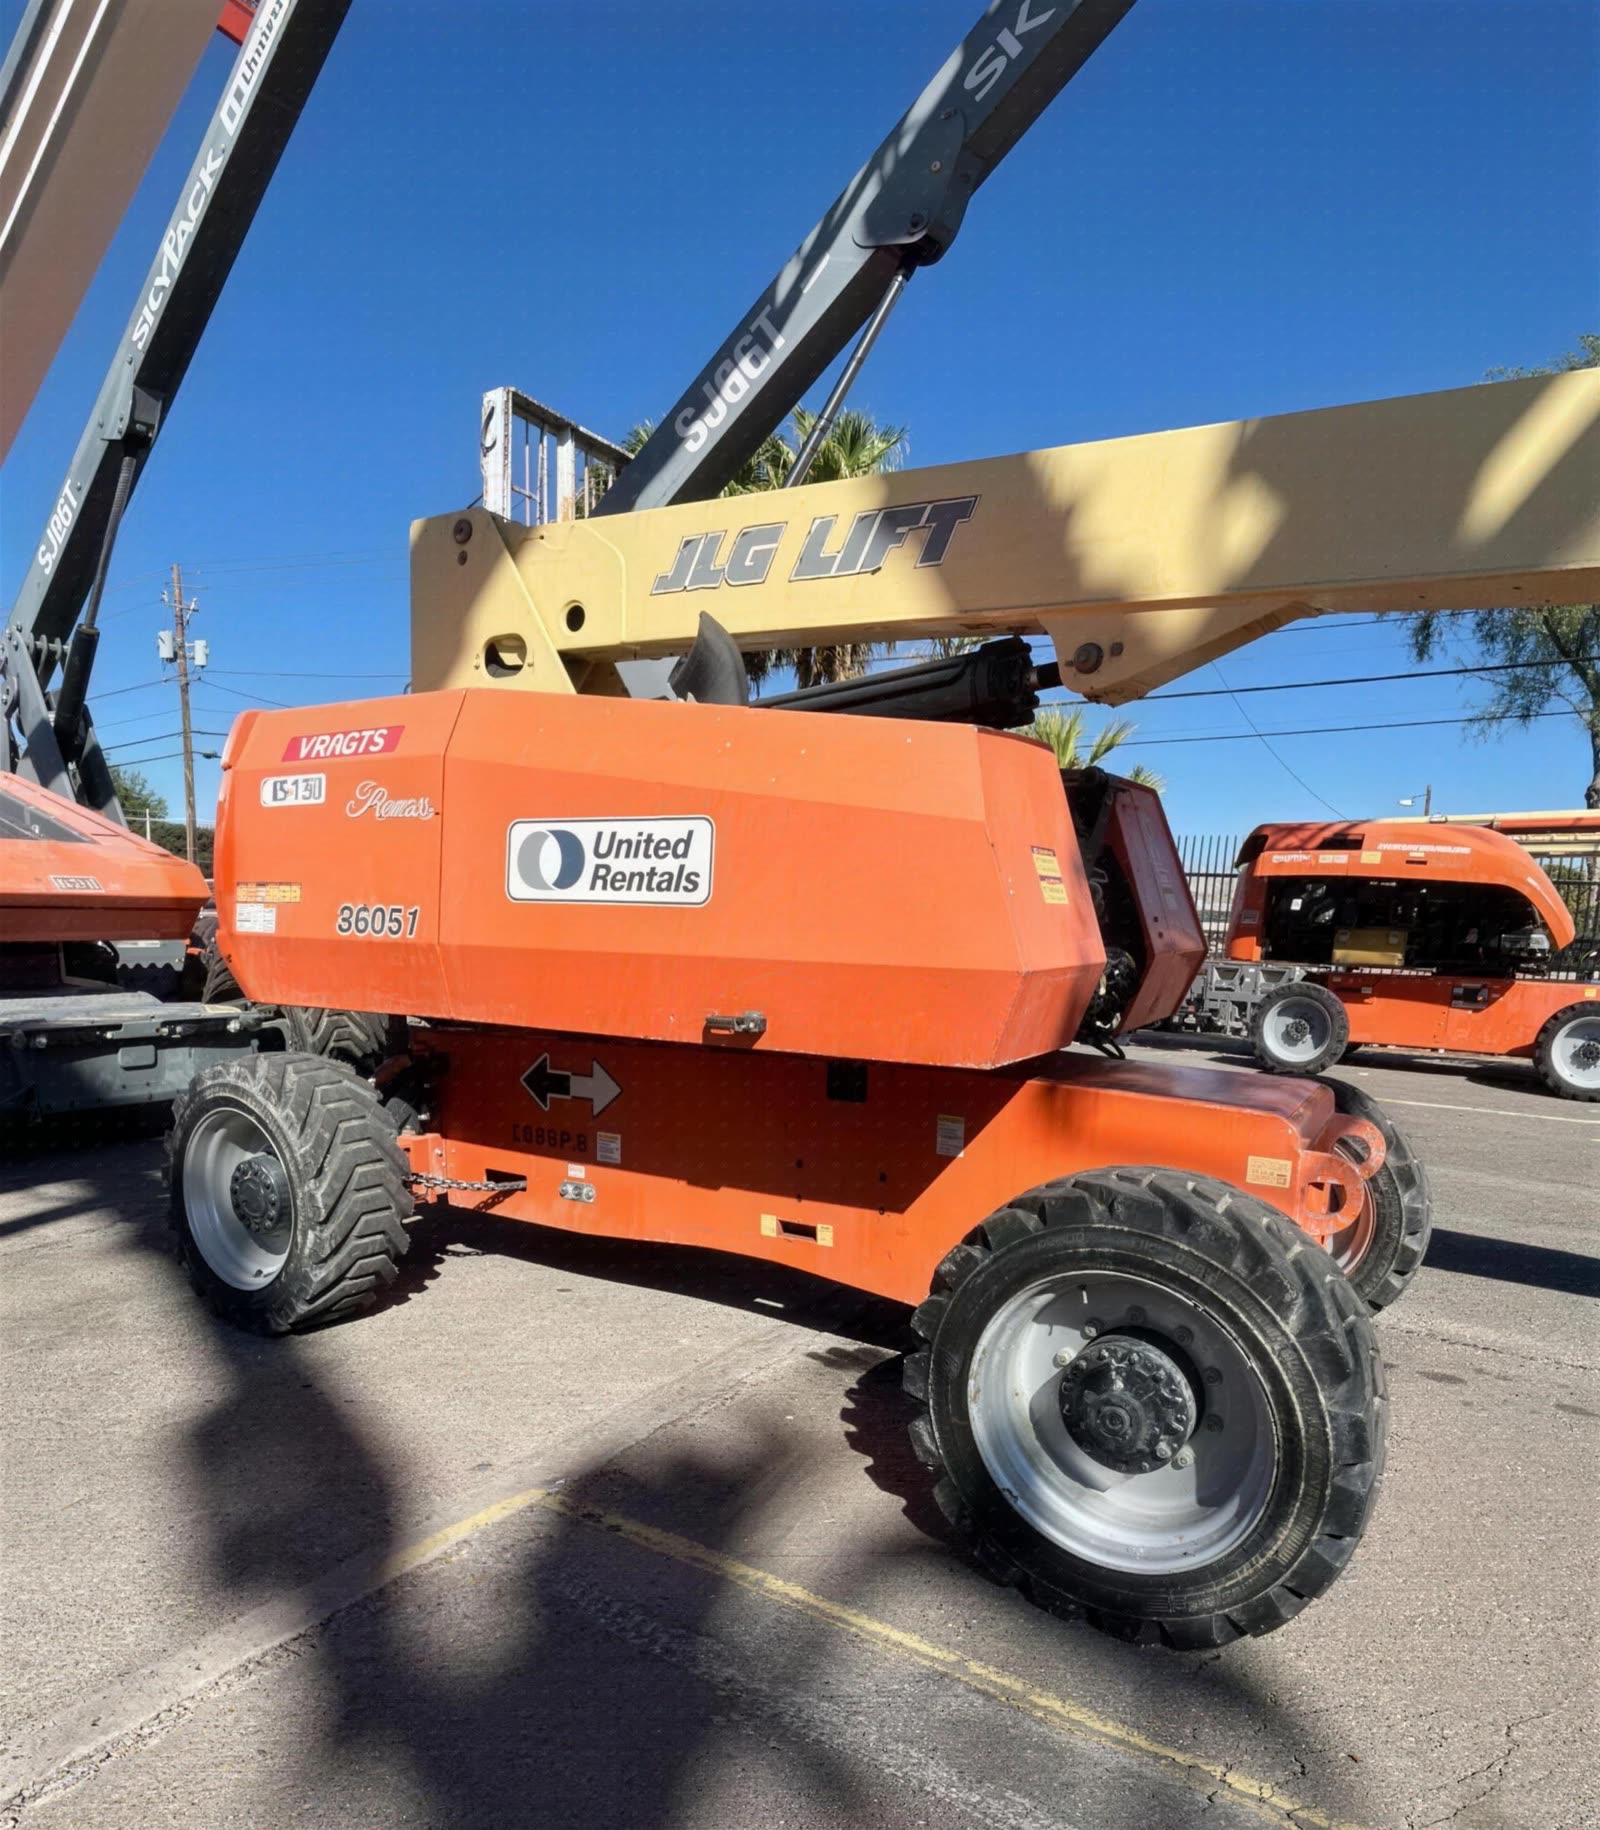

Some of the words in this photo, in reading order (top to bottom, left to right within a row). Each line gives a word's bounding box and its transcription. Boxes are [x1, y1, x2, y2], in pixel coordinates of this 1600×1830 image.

[650, 521, 788, 596] JLG
[789, 494, 982, 583] LIFT
[592, 830, 694, 860] United
[589, 864, 701, 893] Rentals
[337, 904, 418, 938] 36051
